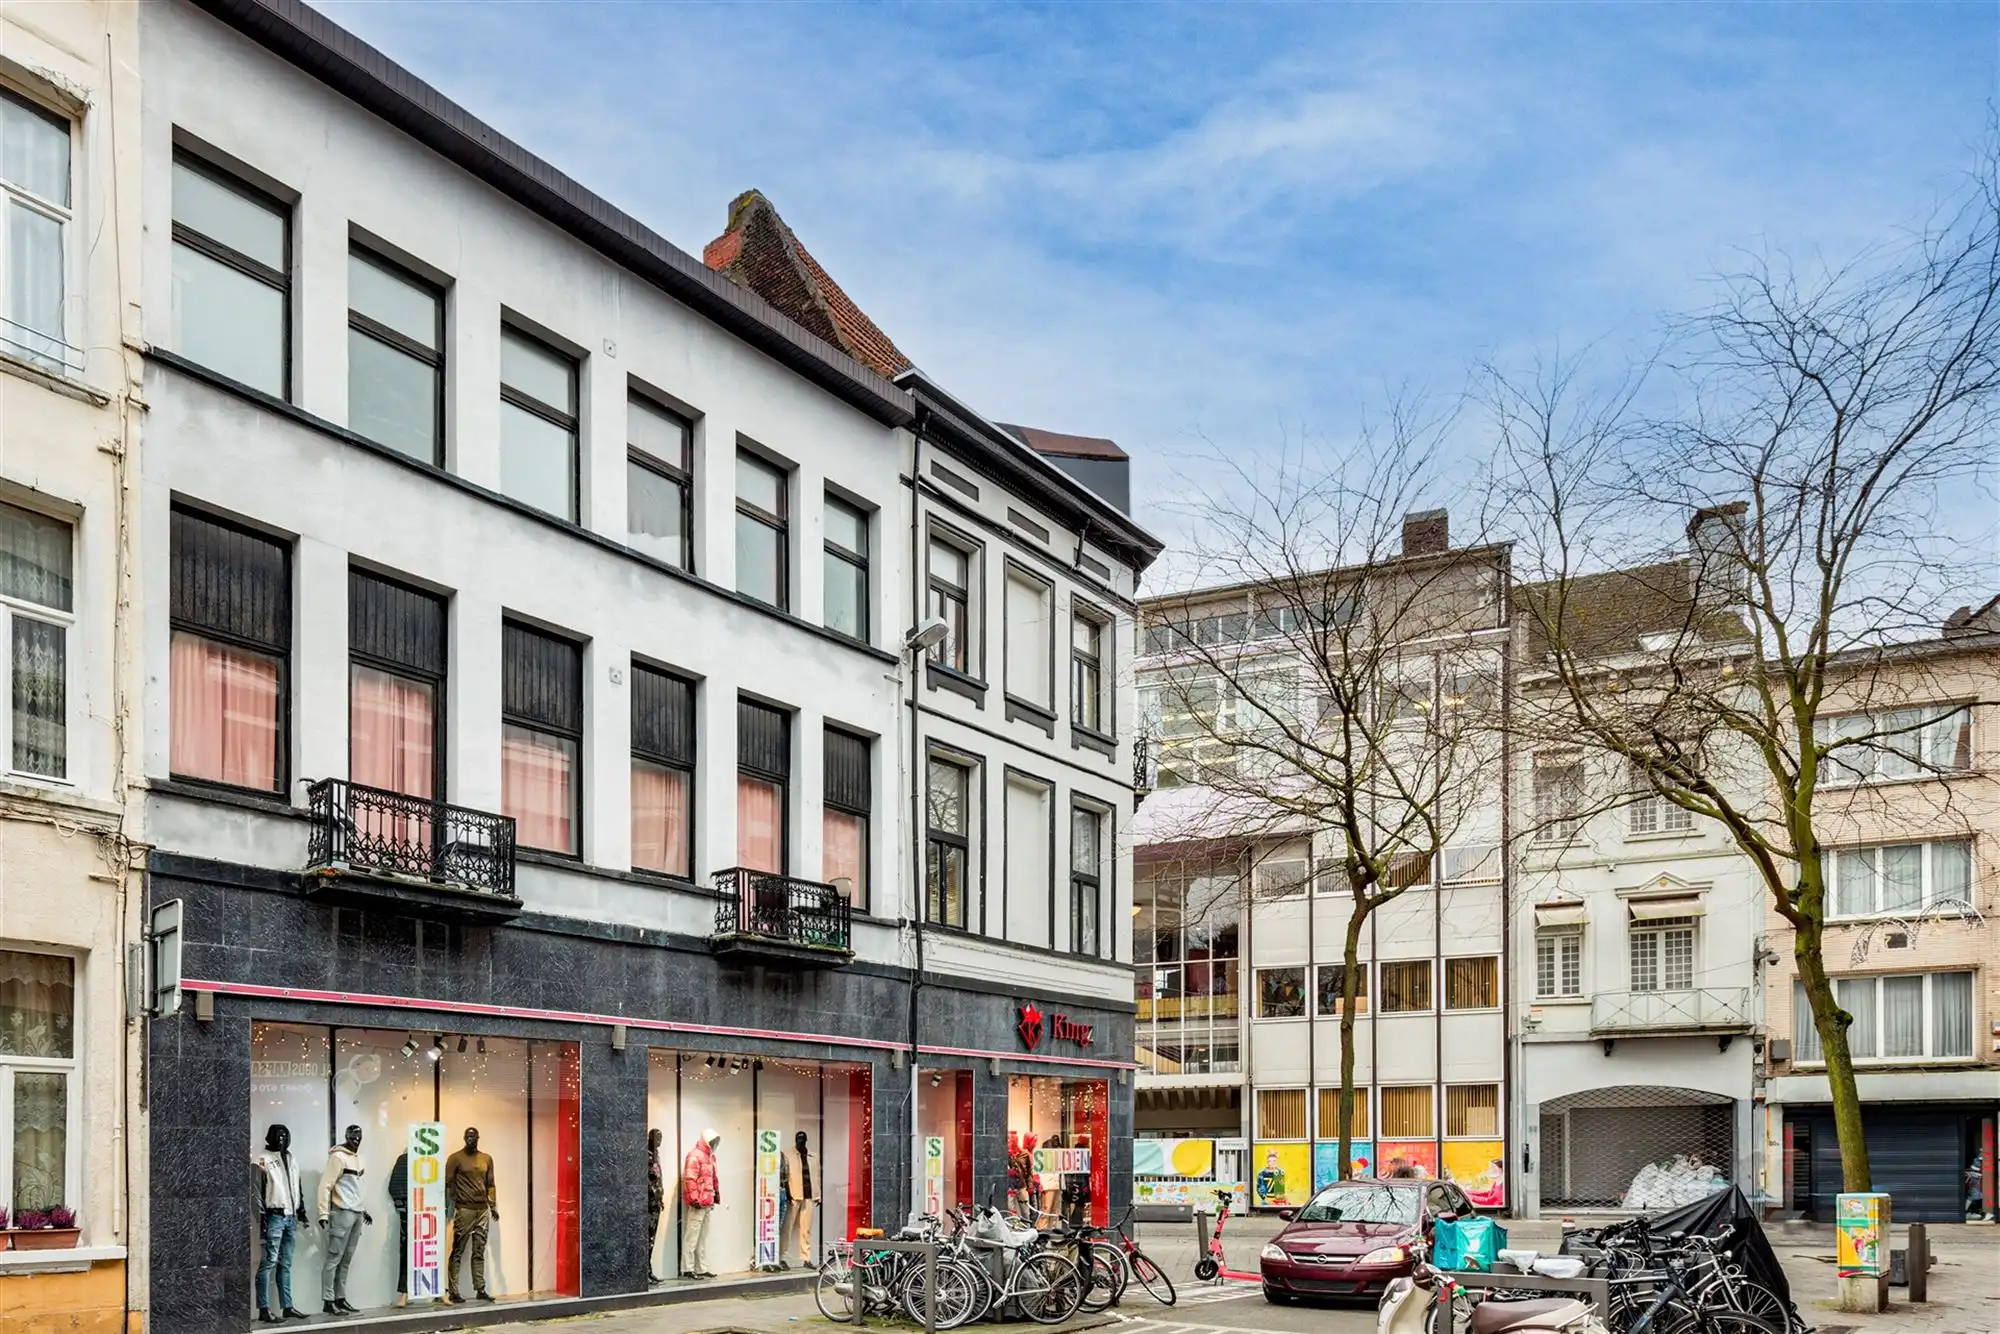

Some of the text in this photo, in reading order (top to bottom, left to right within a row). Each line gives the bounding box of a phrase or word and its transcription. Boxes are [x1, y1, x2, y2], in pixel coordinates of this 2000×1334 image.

[1051, 1012, 1094, 1048] Kingz
[759, 1130, 777, 1264] SOLDEN
[928, 1137, 941, 1215] SOLD
[1033, 1149, 1091, 1173] SOLDEN
[413, 1127, 440, 1297] SOLDEN
